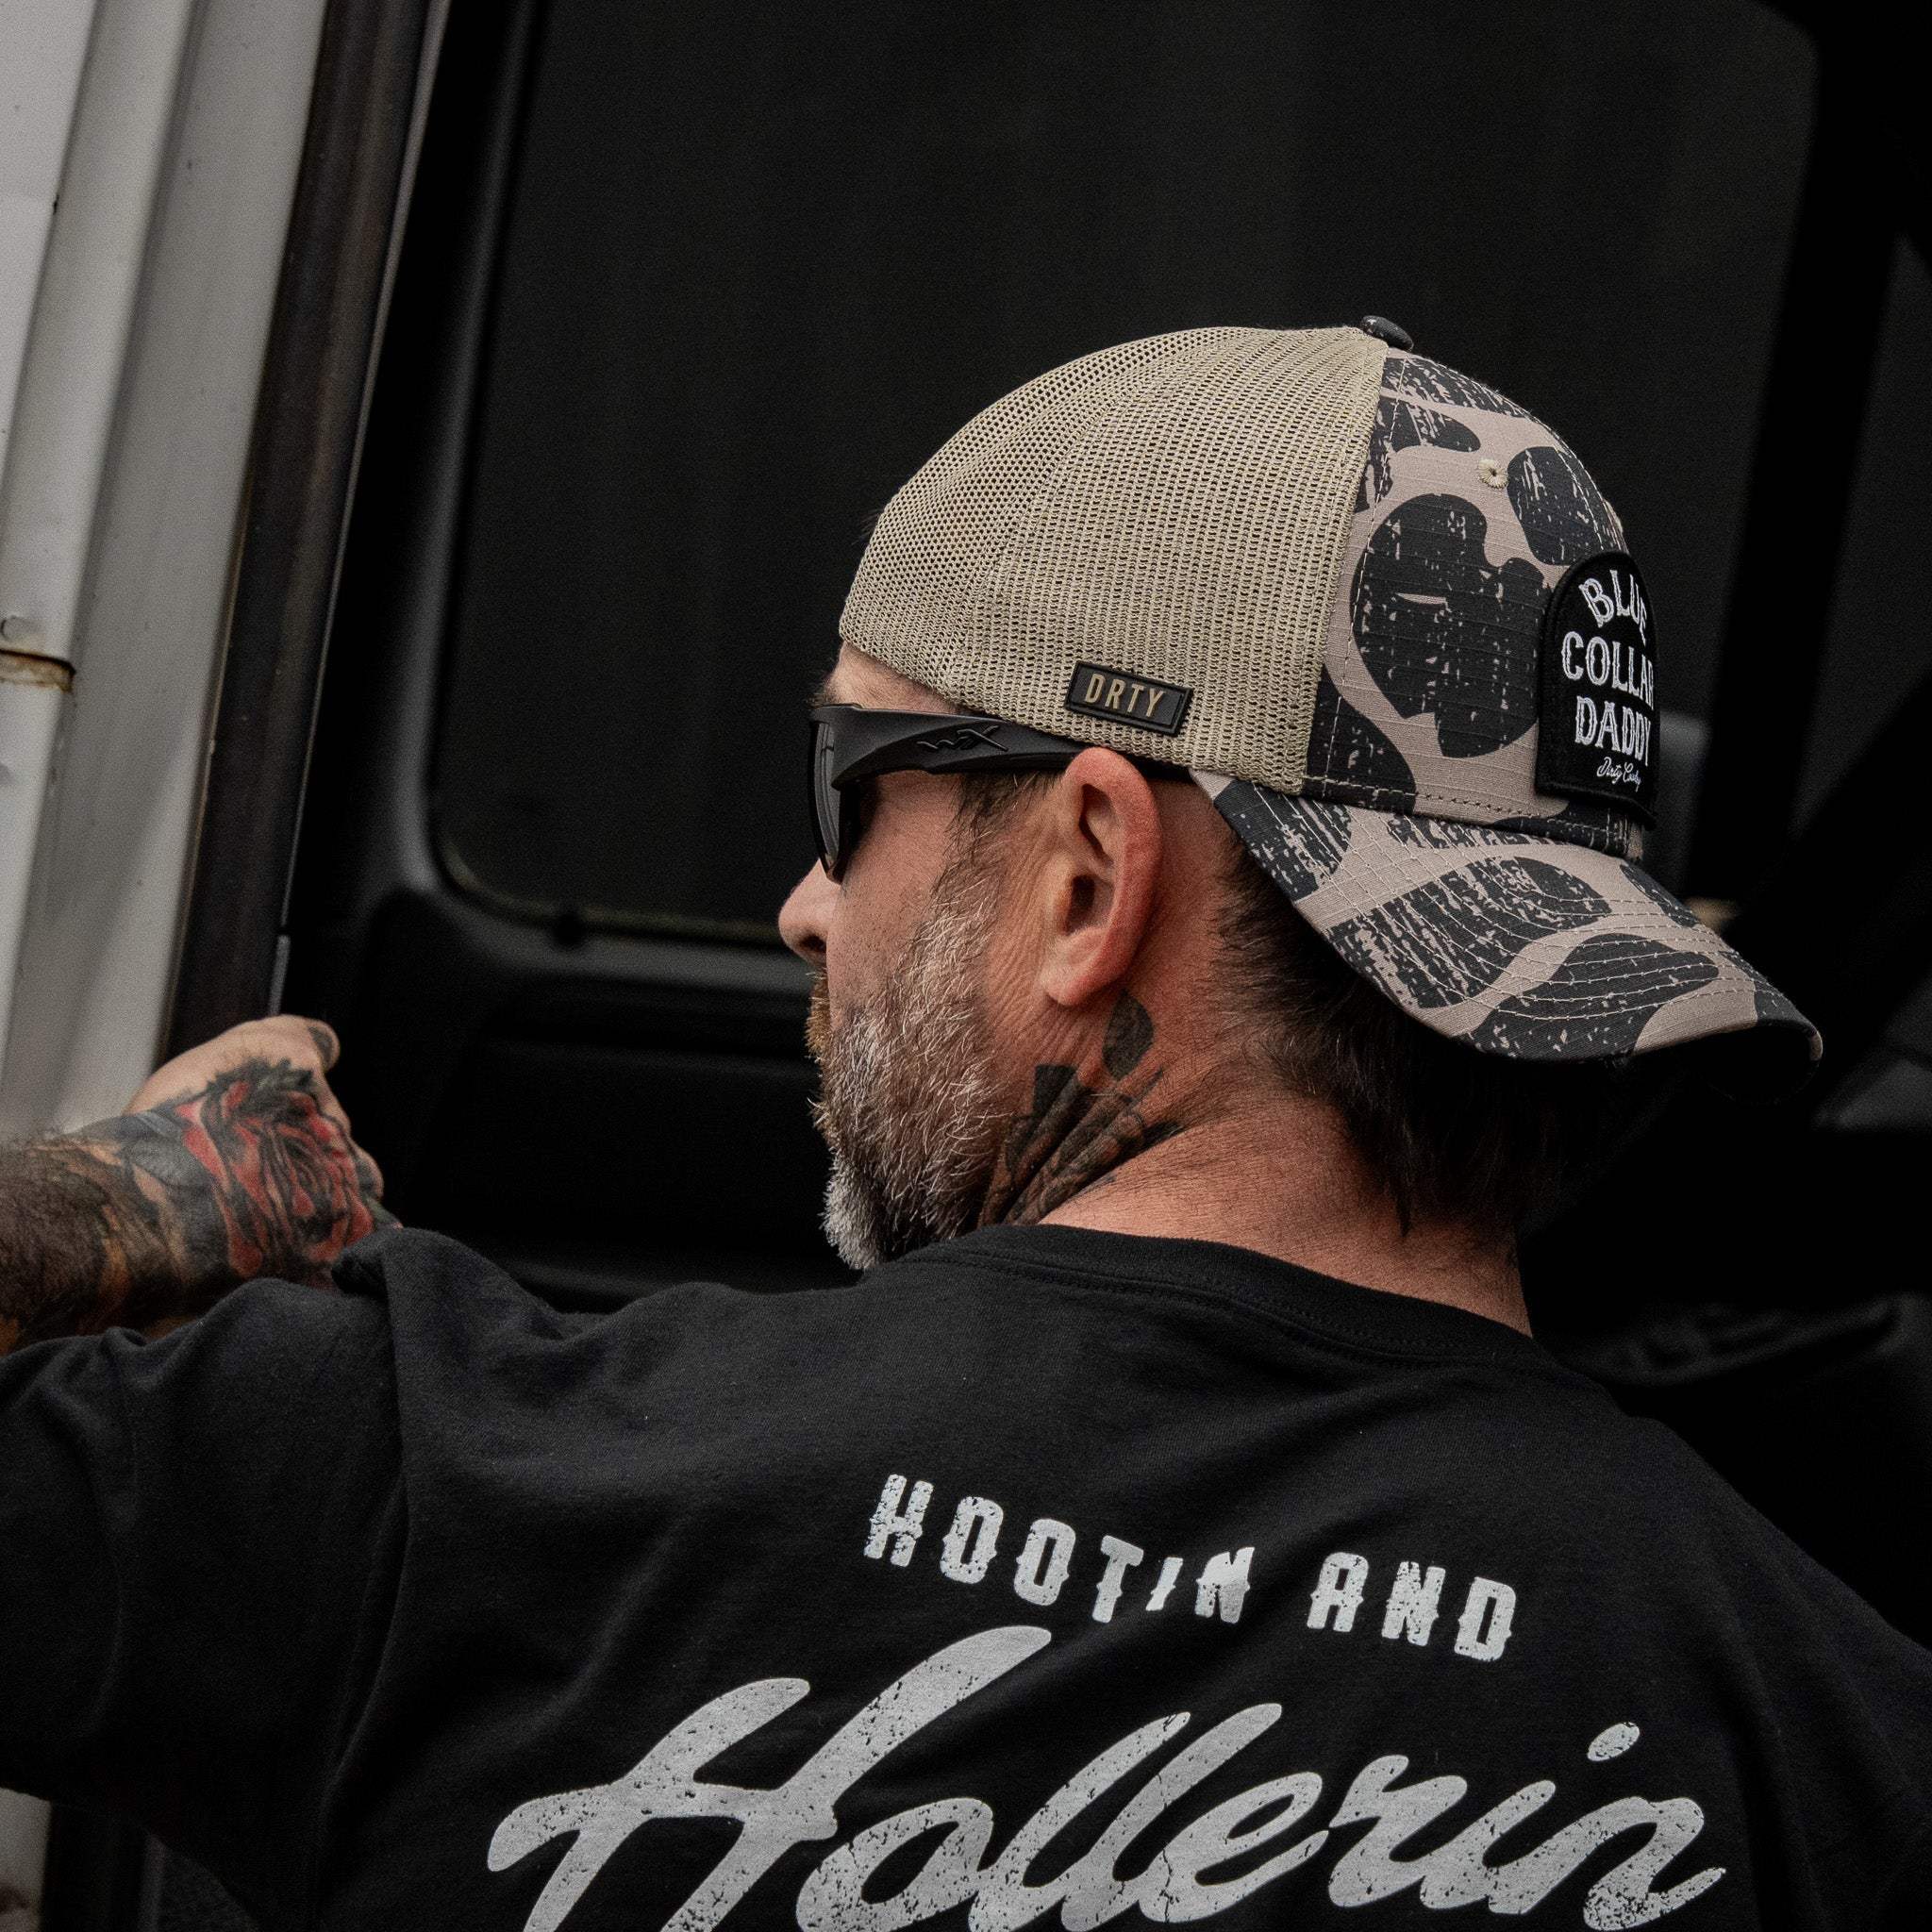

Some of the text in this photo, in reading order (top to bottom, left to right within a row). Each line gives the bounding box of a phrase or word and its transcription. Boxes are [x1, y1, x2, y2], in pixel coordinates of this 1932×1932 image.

[1085, 674, 1165, 718] DRTY
[1574, 695, 1651, 766] DADDY
[864, 1474, 1517, 1662] HOOTIN AND
[487, 1624, 1726, 1932] Hollerin
